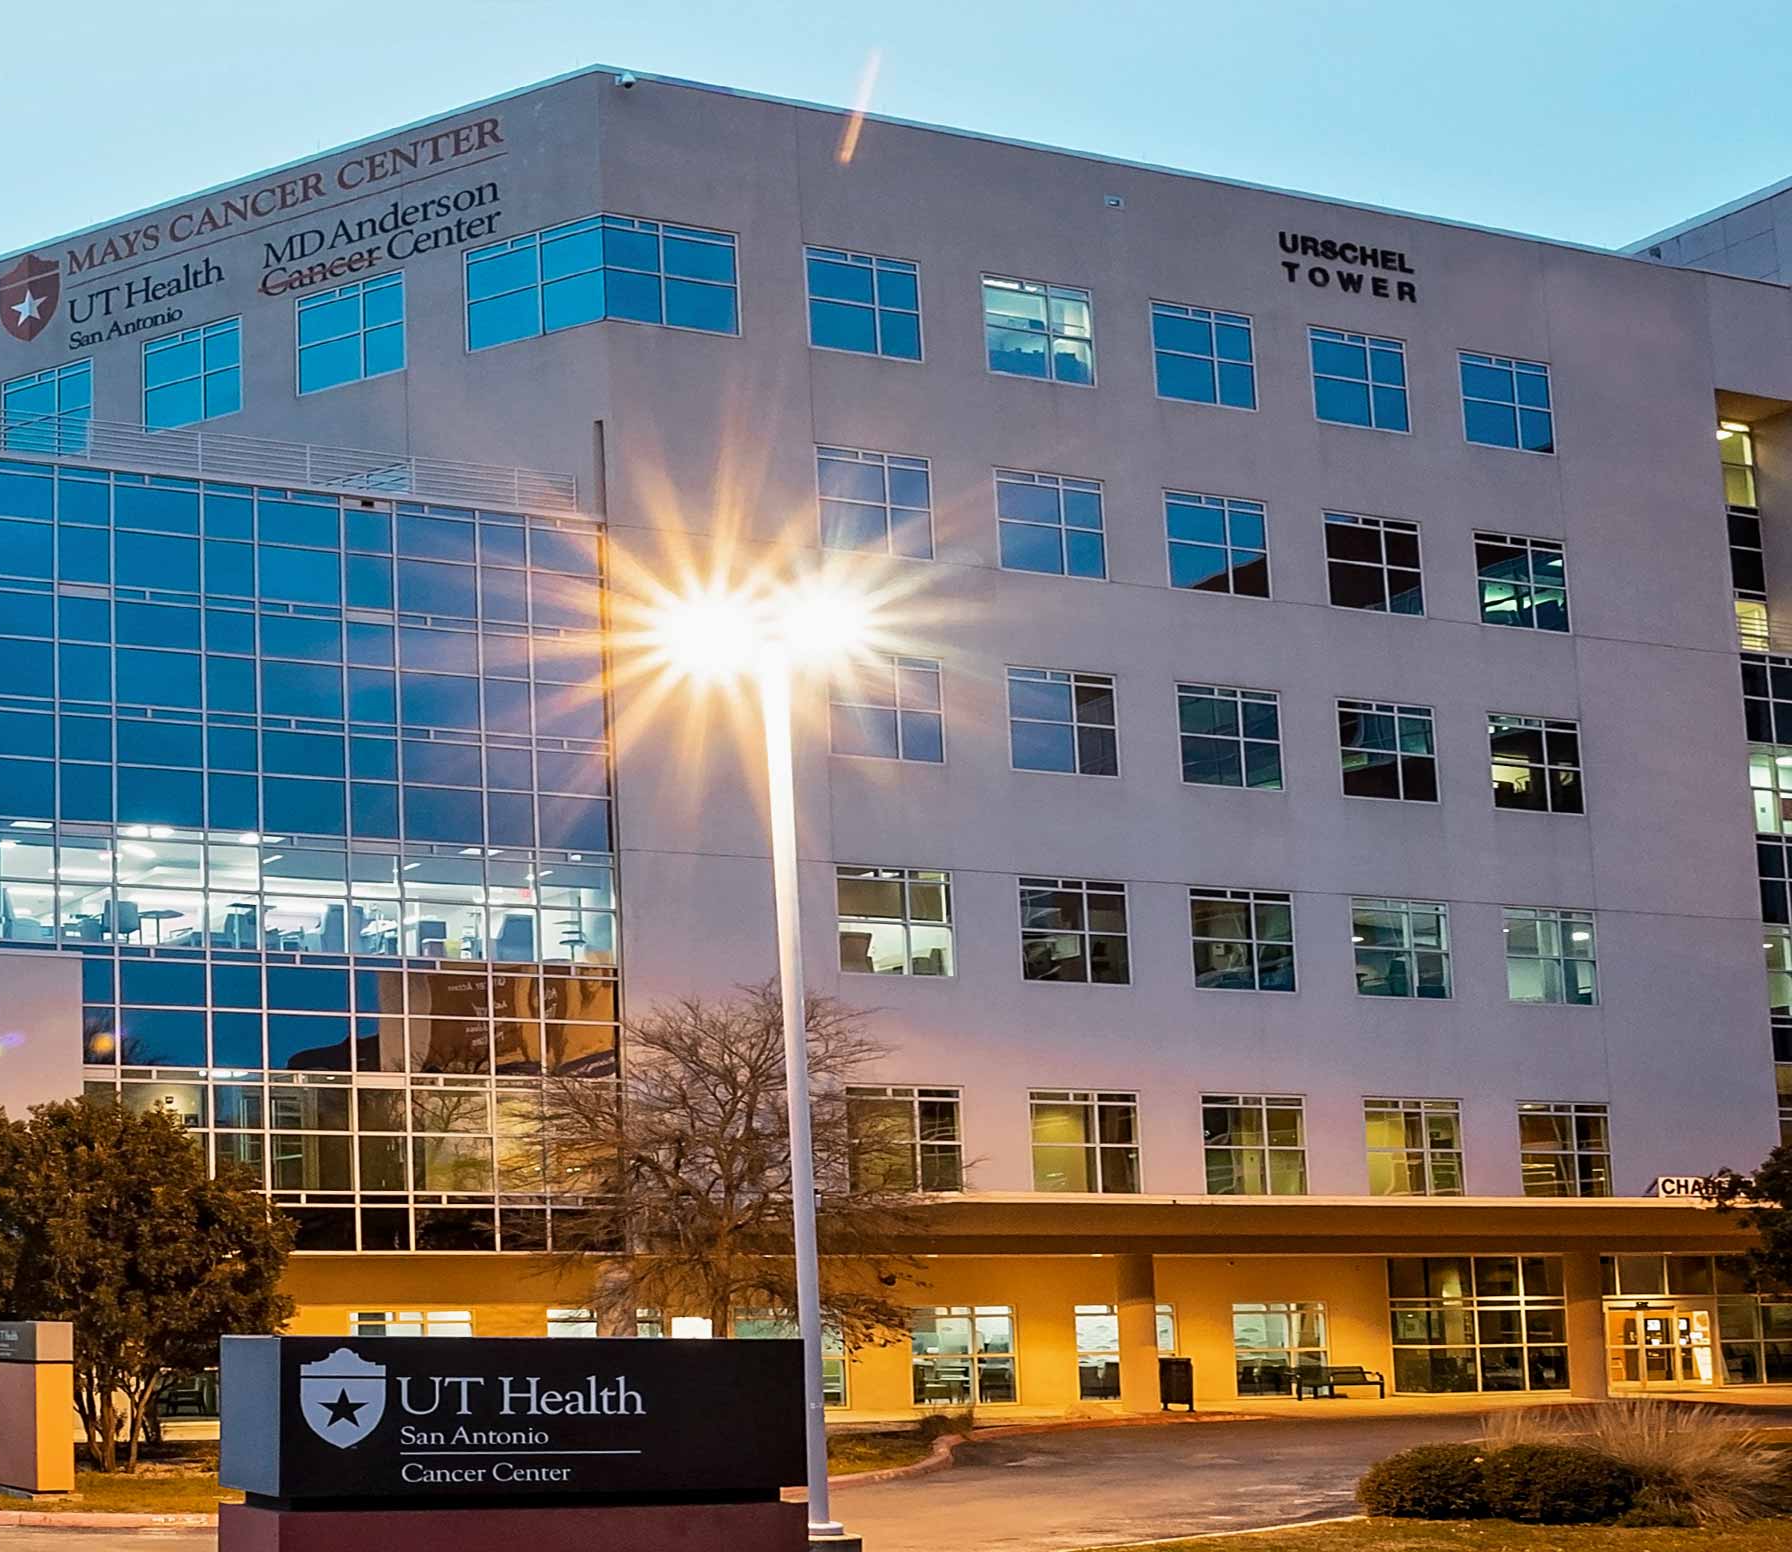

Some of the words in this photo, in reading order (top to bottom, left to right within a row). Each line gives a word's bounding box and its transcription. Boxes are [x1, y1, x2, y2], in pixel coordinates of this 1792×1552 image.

[67, 225, 160, 276] MAYS
[169, 173, 326, 242] CANCER
[337, 118, 504, 190] CENTER
[263, 230, 325, 269] MD
[327, 182, 501, 250] Anderson
[260, 245, 382, 297] Cancer
[387, 211, 502, 260] Center
[1278, 231, 1414, 274] URSCHEL
[68, 287, 120, 324] UT
[125, 256, 225, 309] Health
[1281, 261, 1417, 303] TOWER
[69, 330, 103, 350] San
[107, 306, 183, 341] Antonio
[396, 1376, 485, 1415] UT
[498, 1375, 647, 1415] Health
[400, 1426, 445, 1445] San
[450, 1426, 550, 1445] Antonio
[401, 1462, 487, 1483] Cancer
[492, 1462, 571, 1482] Center
